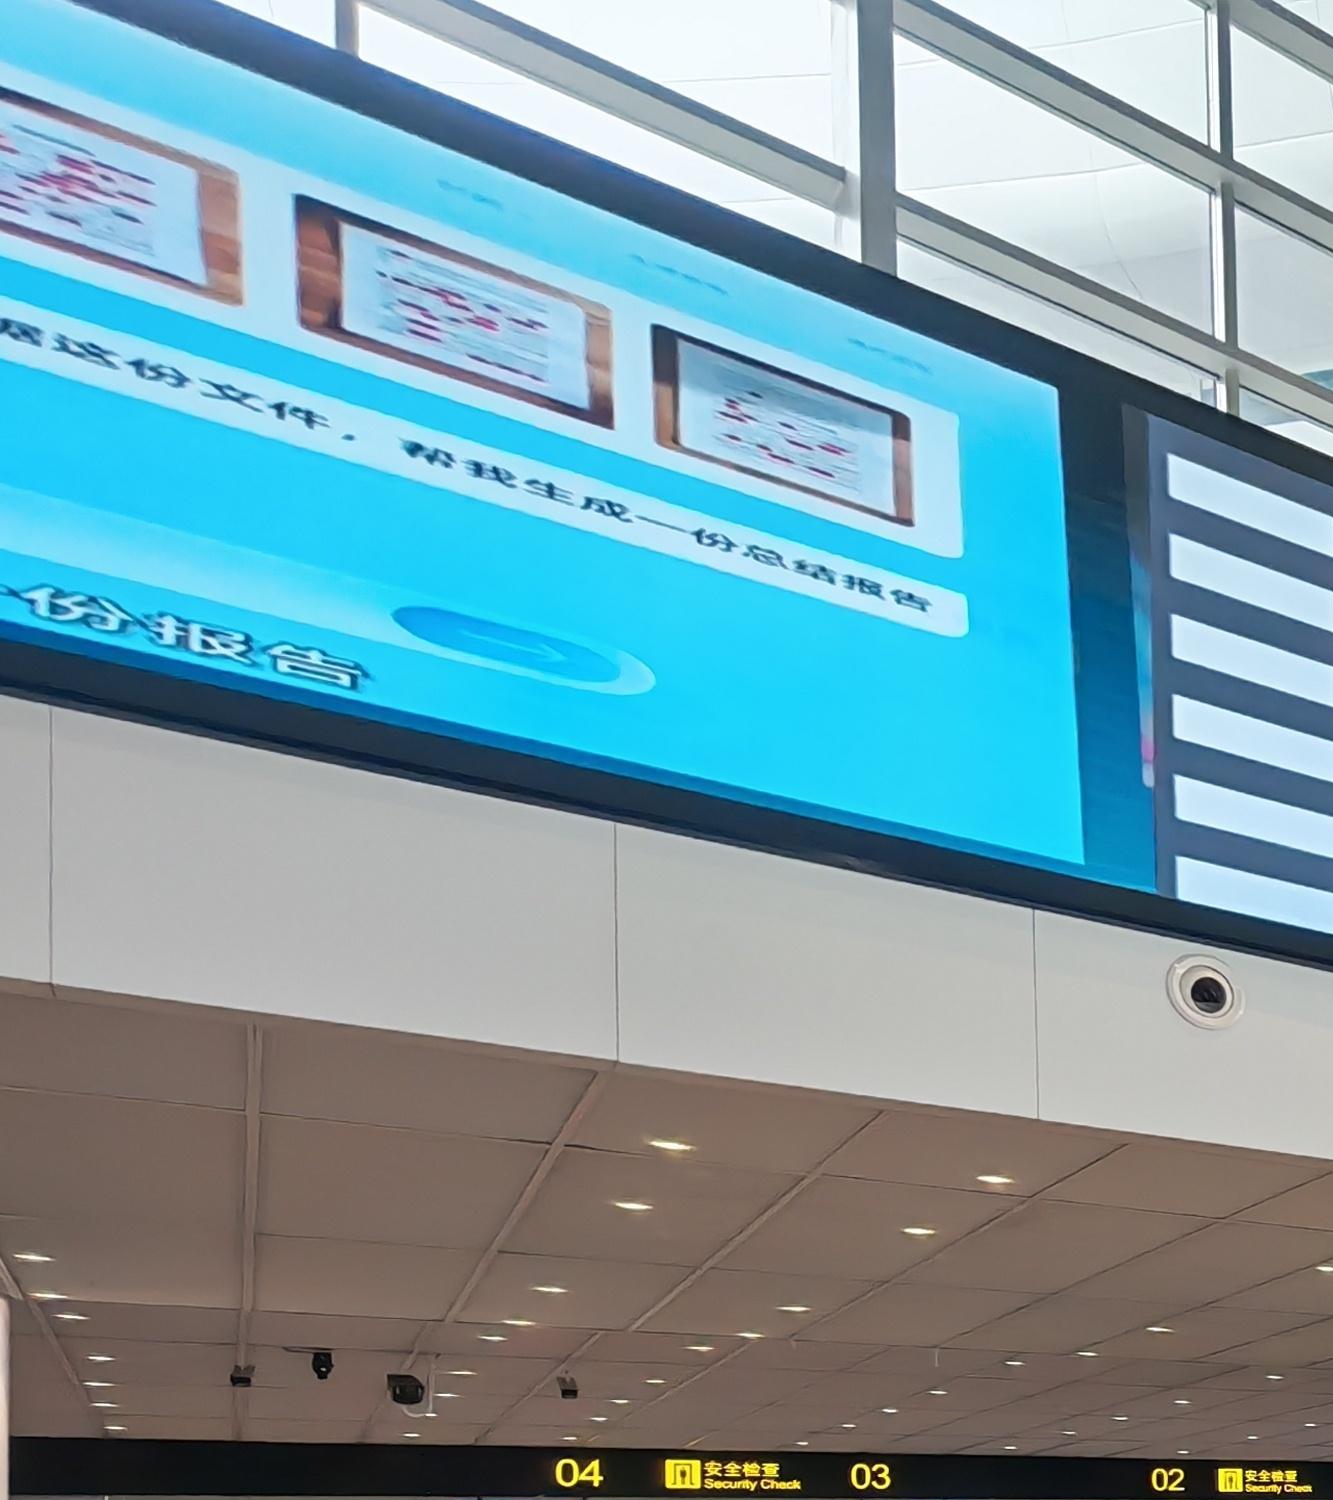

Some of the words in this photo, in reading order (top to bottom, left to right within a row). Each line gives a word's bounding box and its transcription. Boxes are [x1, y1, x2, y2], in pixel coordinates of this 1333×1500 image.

[555, 1459, 604, 1487] 04
[703, 1460, 780, 1478] 安全检查
[850, 1463, 892, 1490] 03
[1244, 1470, 1298, 1483] 安全检查
[703, 1478, 757, 1491] Security
[760, 1479, 801, 1490] Check
[1151, 1468, 1185, 1491] 02
[1245, 1484, 1281, 1494] Security
[1284, 1484, 1312, 1493] Check
